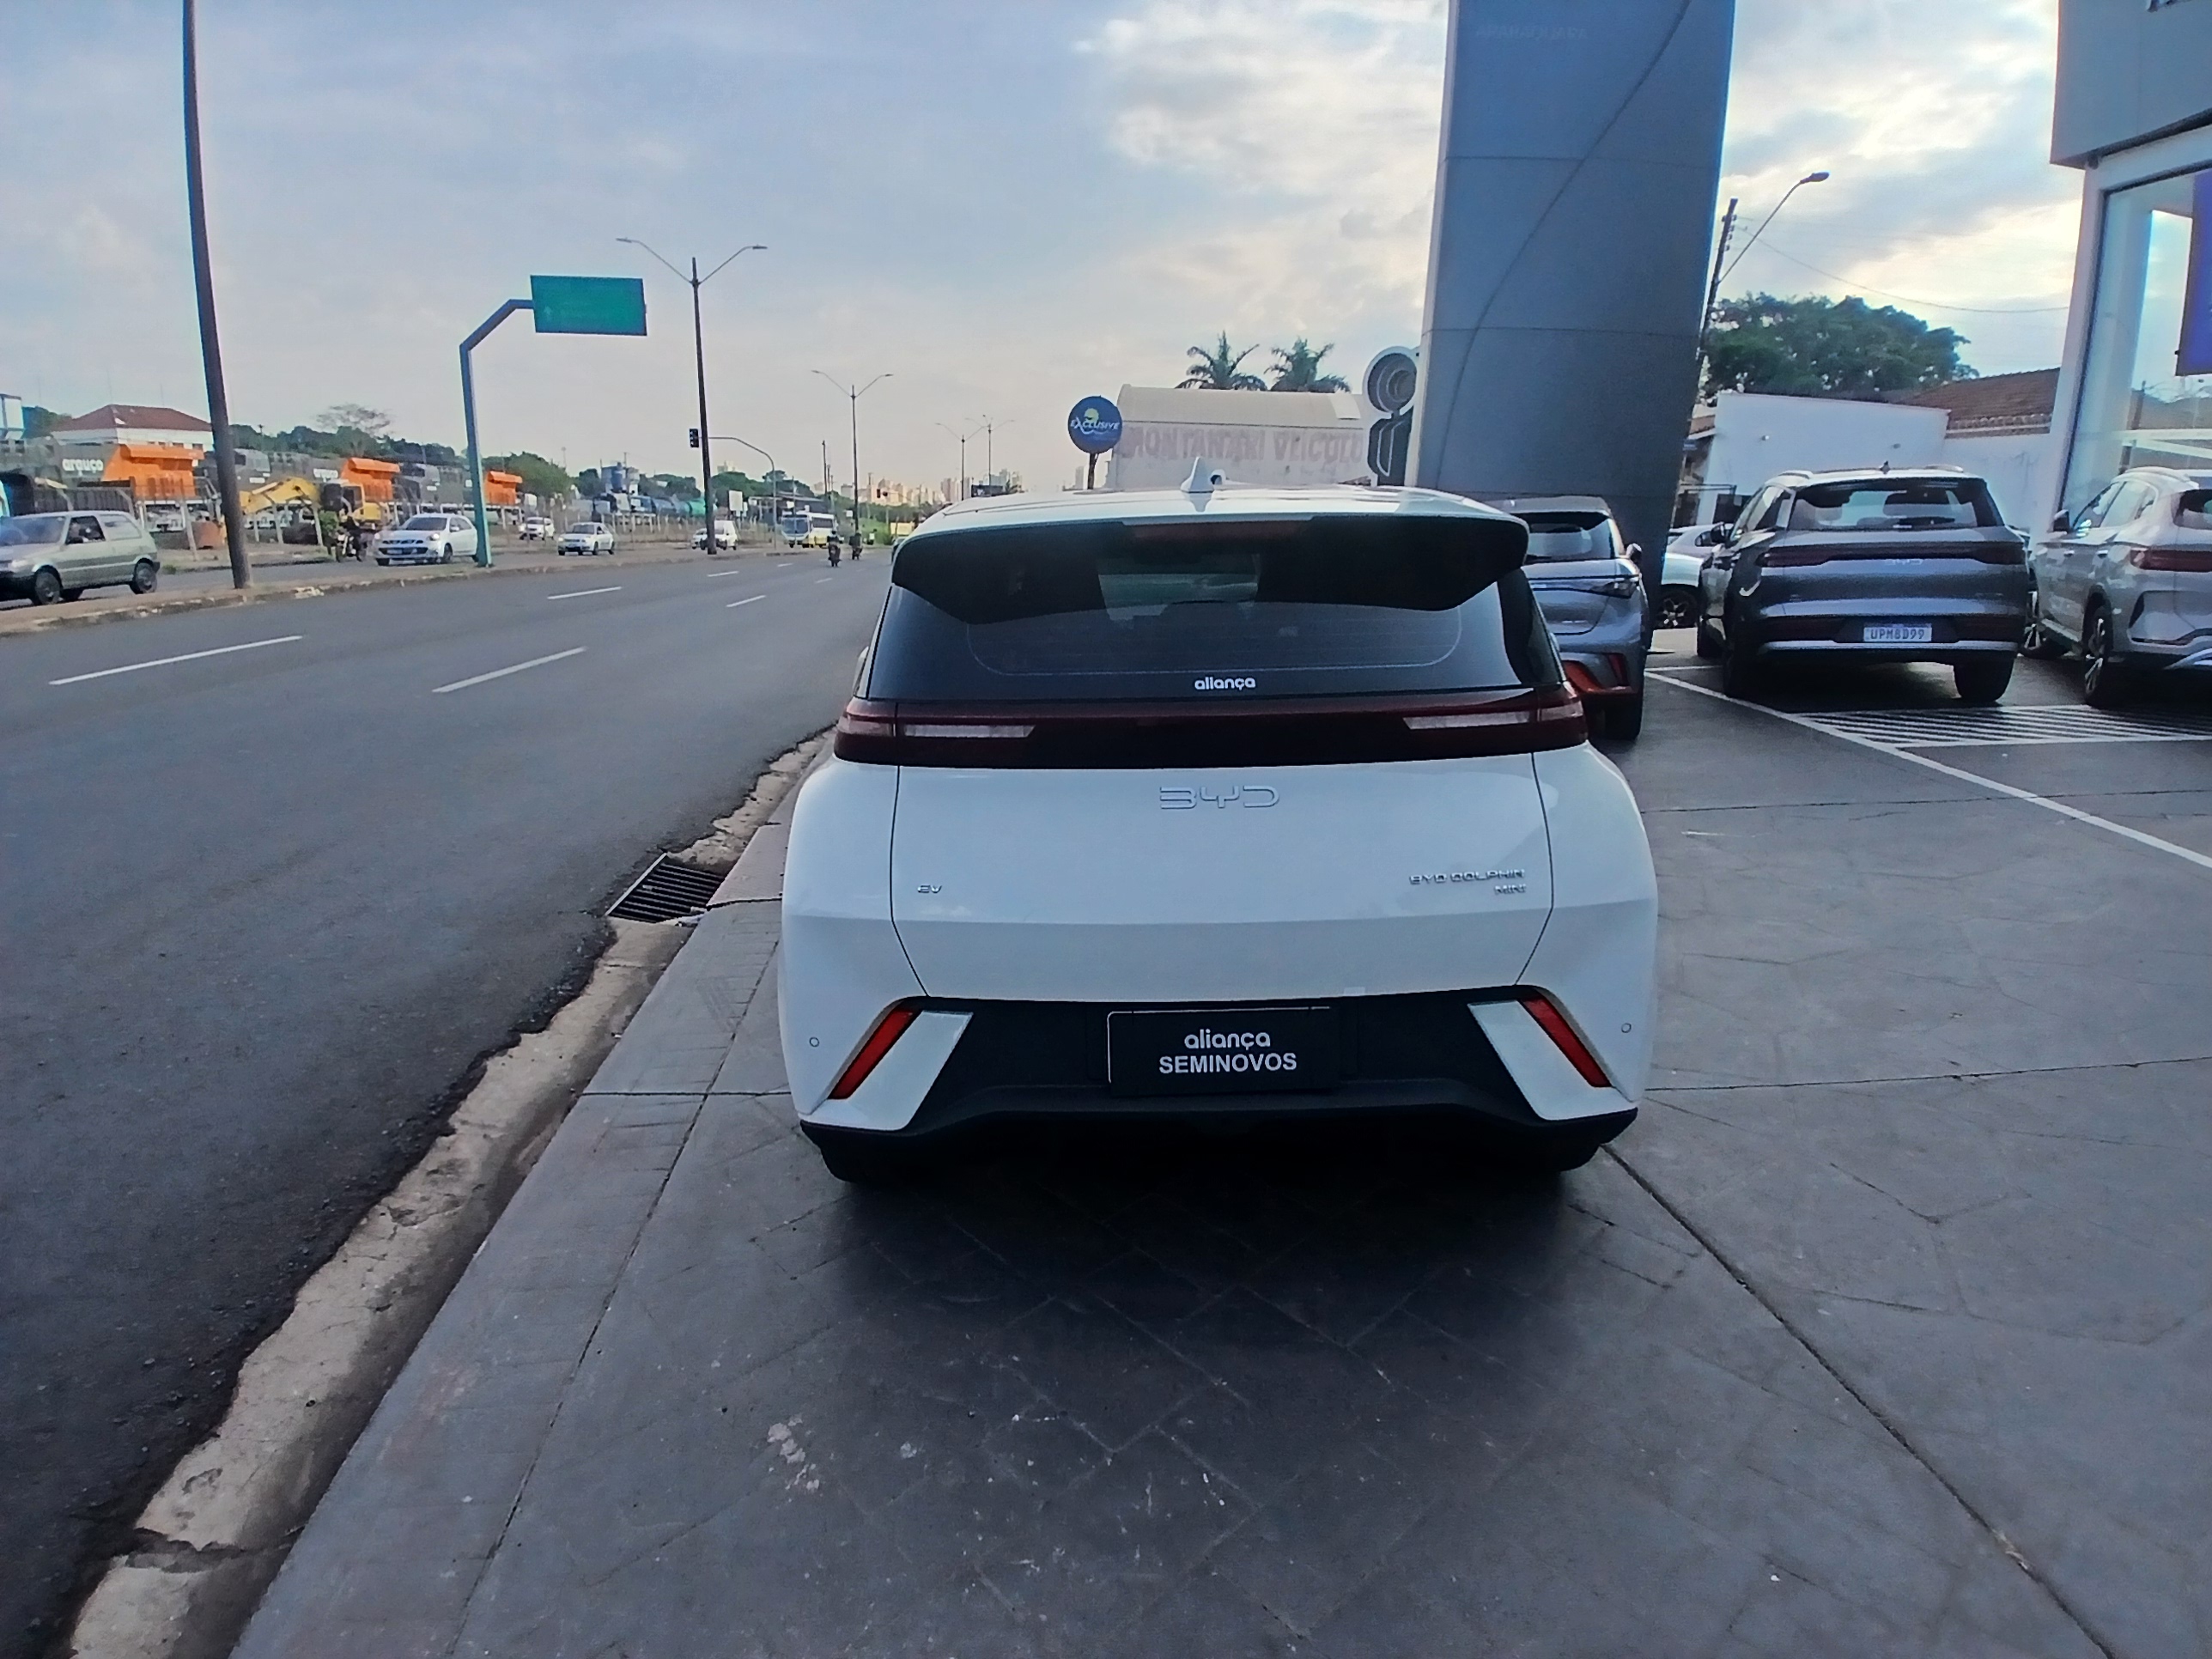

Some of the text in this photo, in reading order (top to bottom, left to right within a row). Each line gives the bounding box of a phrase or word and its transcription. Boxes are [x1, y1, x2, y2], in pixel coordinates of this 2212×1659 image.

[1870, 629, 1925, 640] UPM8D99
[1194, 677, 1256, 690] aliança
[1159, 785, 1280, 809] BYD
[1409, 869, 1525, 884] BYD DOLPHIN
[917, 884, 942, 894] EV
[1184, 1029, 1271, 1050] aliança
[1159, 1053, 1297, 1073] SEMINOVOS
